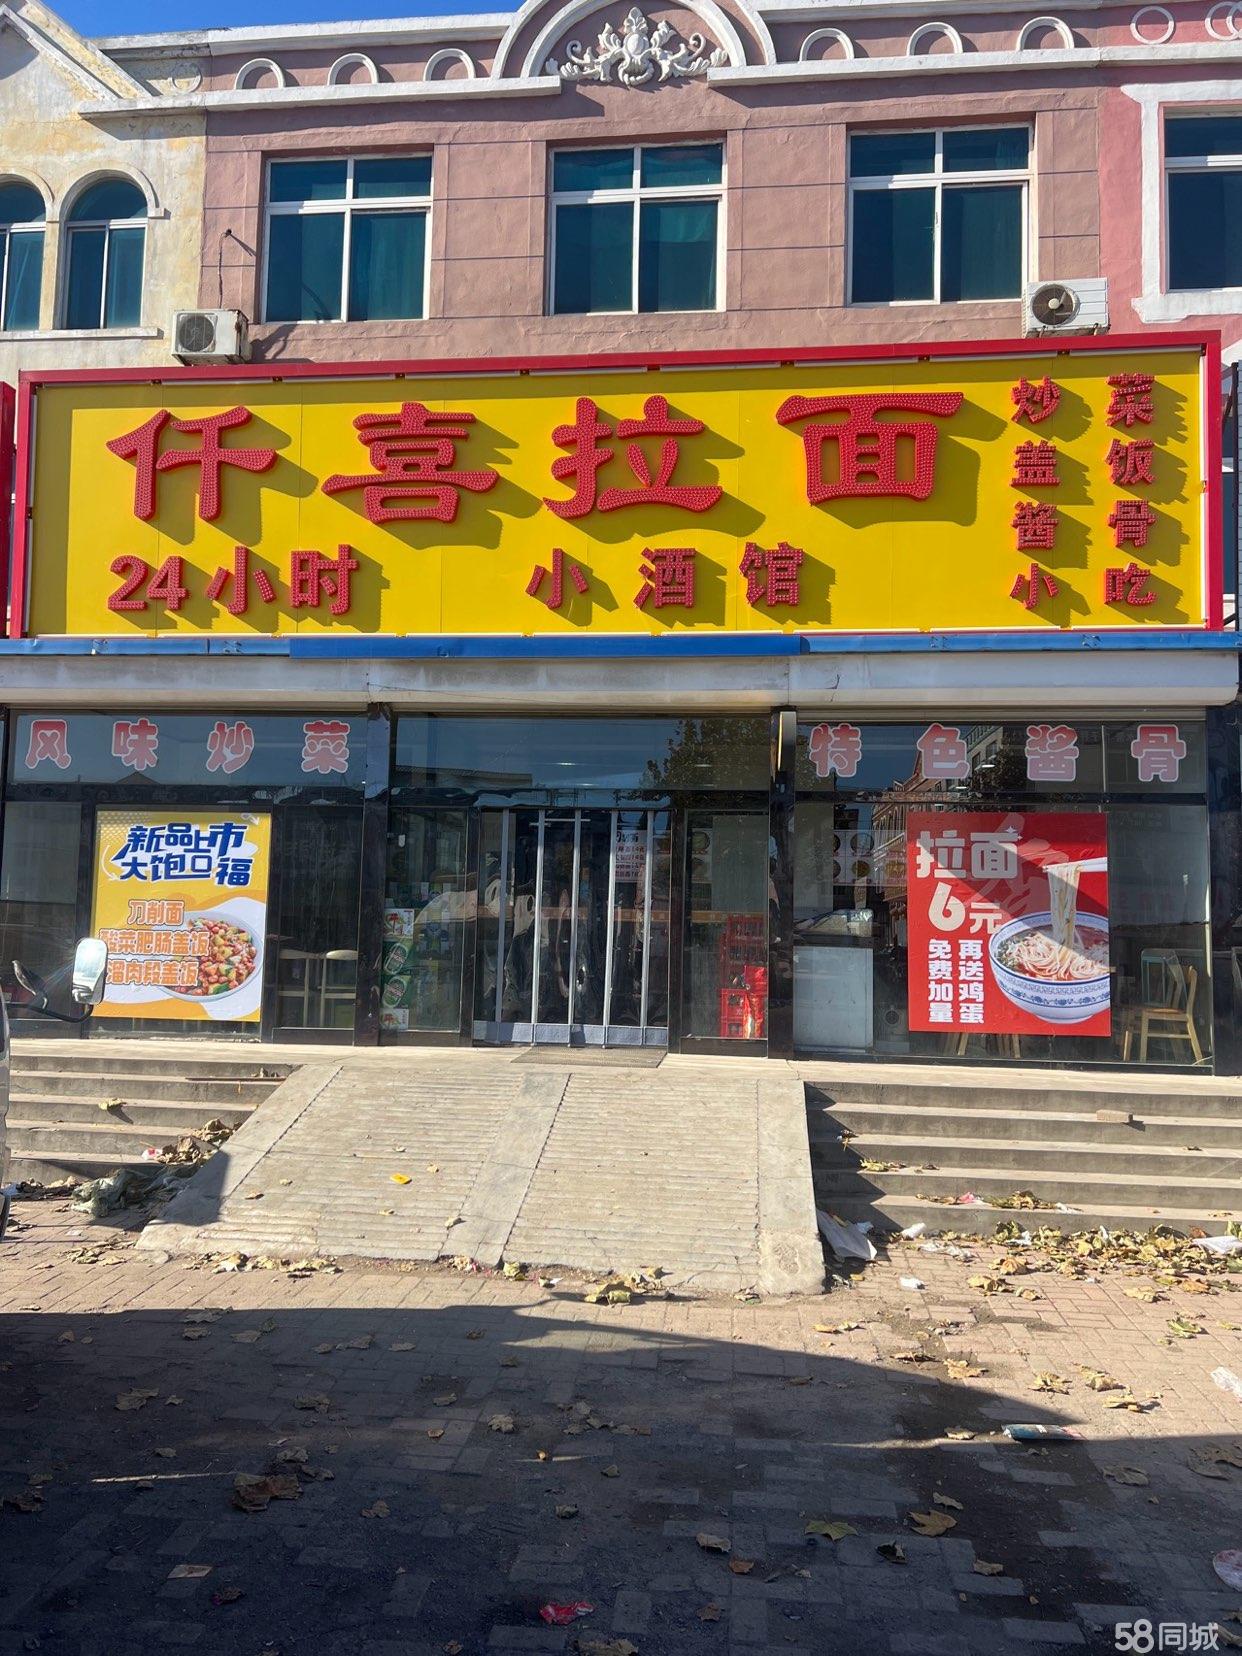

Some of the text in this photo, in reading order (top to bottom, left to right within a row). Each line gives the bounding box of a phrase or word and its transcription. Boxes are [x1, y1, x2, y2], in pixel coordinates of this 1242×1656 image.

[1011, 373, 1155, 427] 炒菜
[106, 391, 963, 524] 仟喜拉面
[1011, 438, 1155, 488] 盖饭
[1011, 500, 1156, 551] 酱骨
[107, 543, 360, 616] 24小时
[525, 541, 804, 610] 小酒馆
[1010, 562, 1157, 610] 小吃
[25, 718, 350, 775] 风味炒菜
[809, 722, 1187, 783] 特色酱骨
[111, 822, 248, 860] 新品上市
[916, 829, 1019, 880] 拉面
[119, 852, 253, 886] 大饱口福
[127, 900, 185, 925] 刀削面
[928, 881, 1003, 935] 6元
[928, 938, 954, 1024] 免费加量
[958, 938, 984, 1024] 再送鸡蛋
